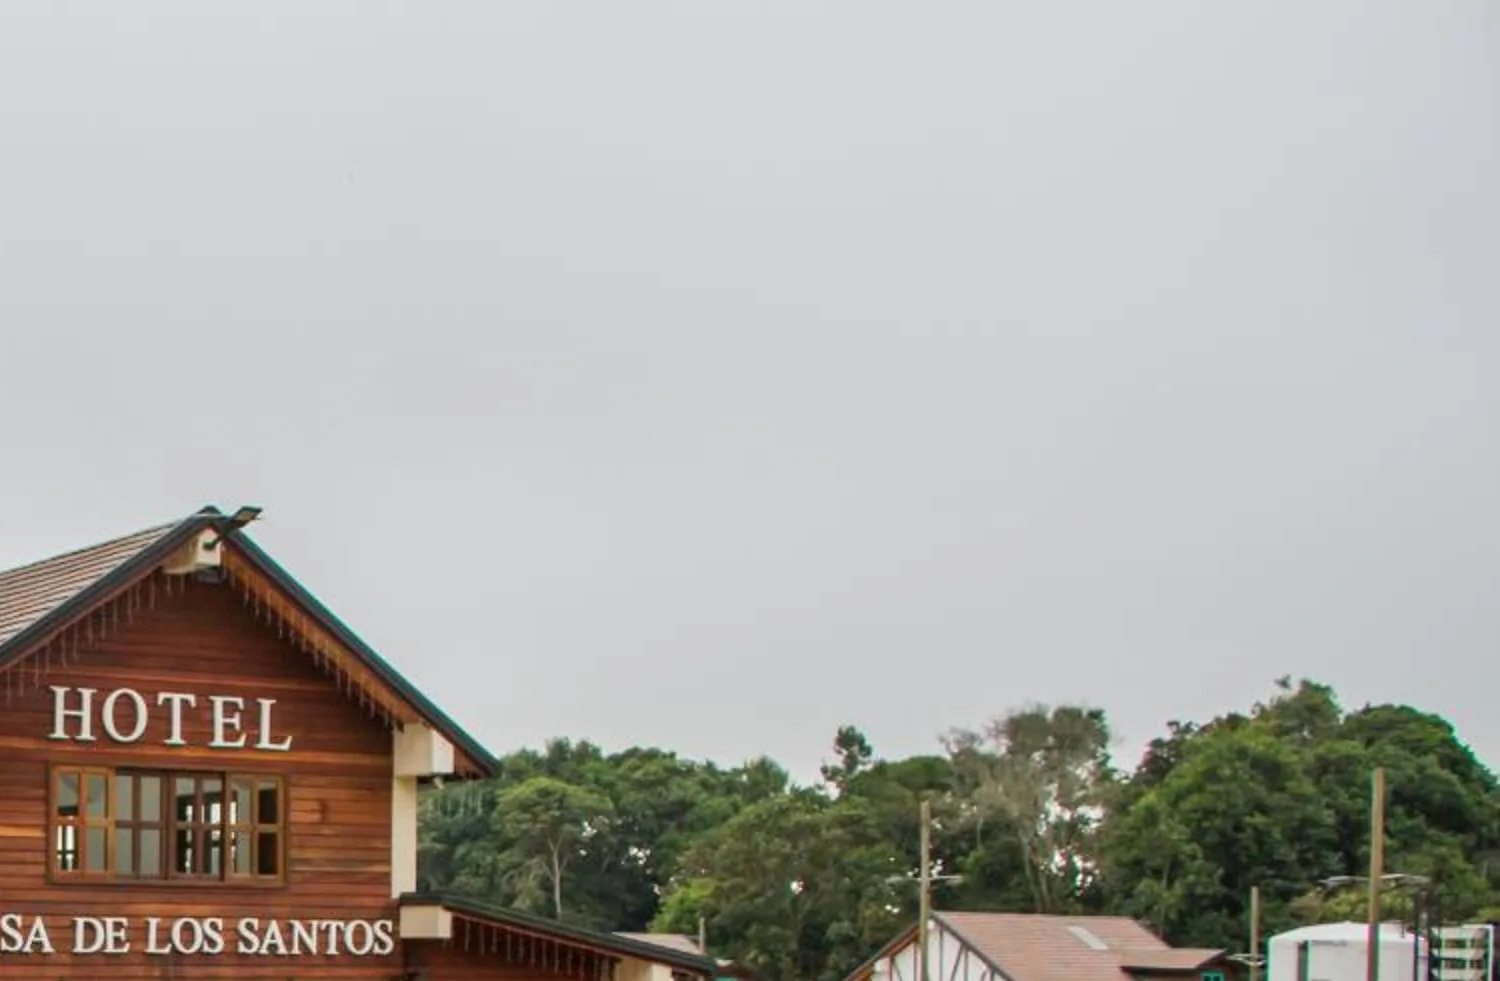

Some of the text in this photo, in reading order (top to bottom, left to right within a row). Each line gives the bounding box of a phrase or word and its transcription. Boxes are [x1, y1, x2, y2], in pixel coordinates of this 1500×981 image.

[48, 685, 293, 751] HOTEL
[72, 916, 130, 954] DE
[145, 917, 225, 955] LOS
[237, 917, 394, 956] SANTOS
